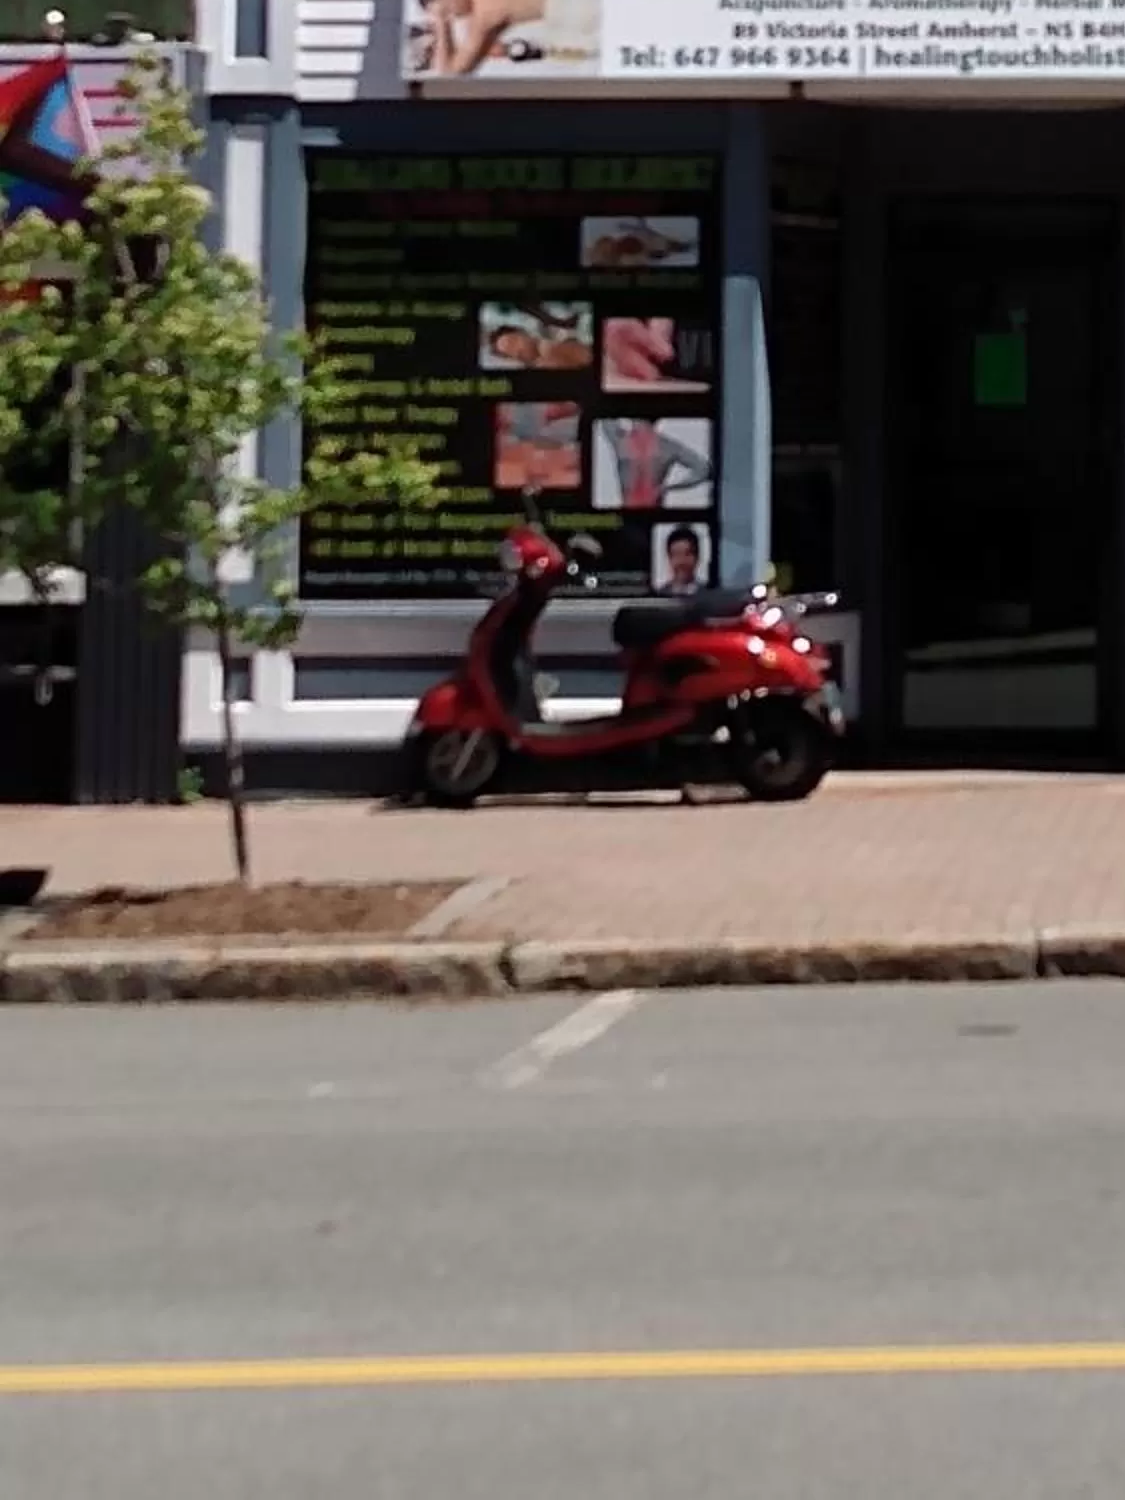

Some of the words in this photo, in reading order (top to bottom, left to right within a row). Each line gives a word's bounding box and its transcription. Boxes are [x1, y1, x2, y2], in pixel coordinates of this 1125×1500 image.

[765, 22, 849, 40] Victoria
[855, 22, 920, 39] Street
[926, 21, 1018, 39] Amherst
[1045, 22, 1073, 39] NS
[619, 46, 664, 67] Tel:
